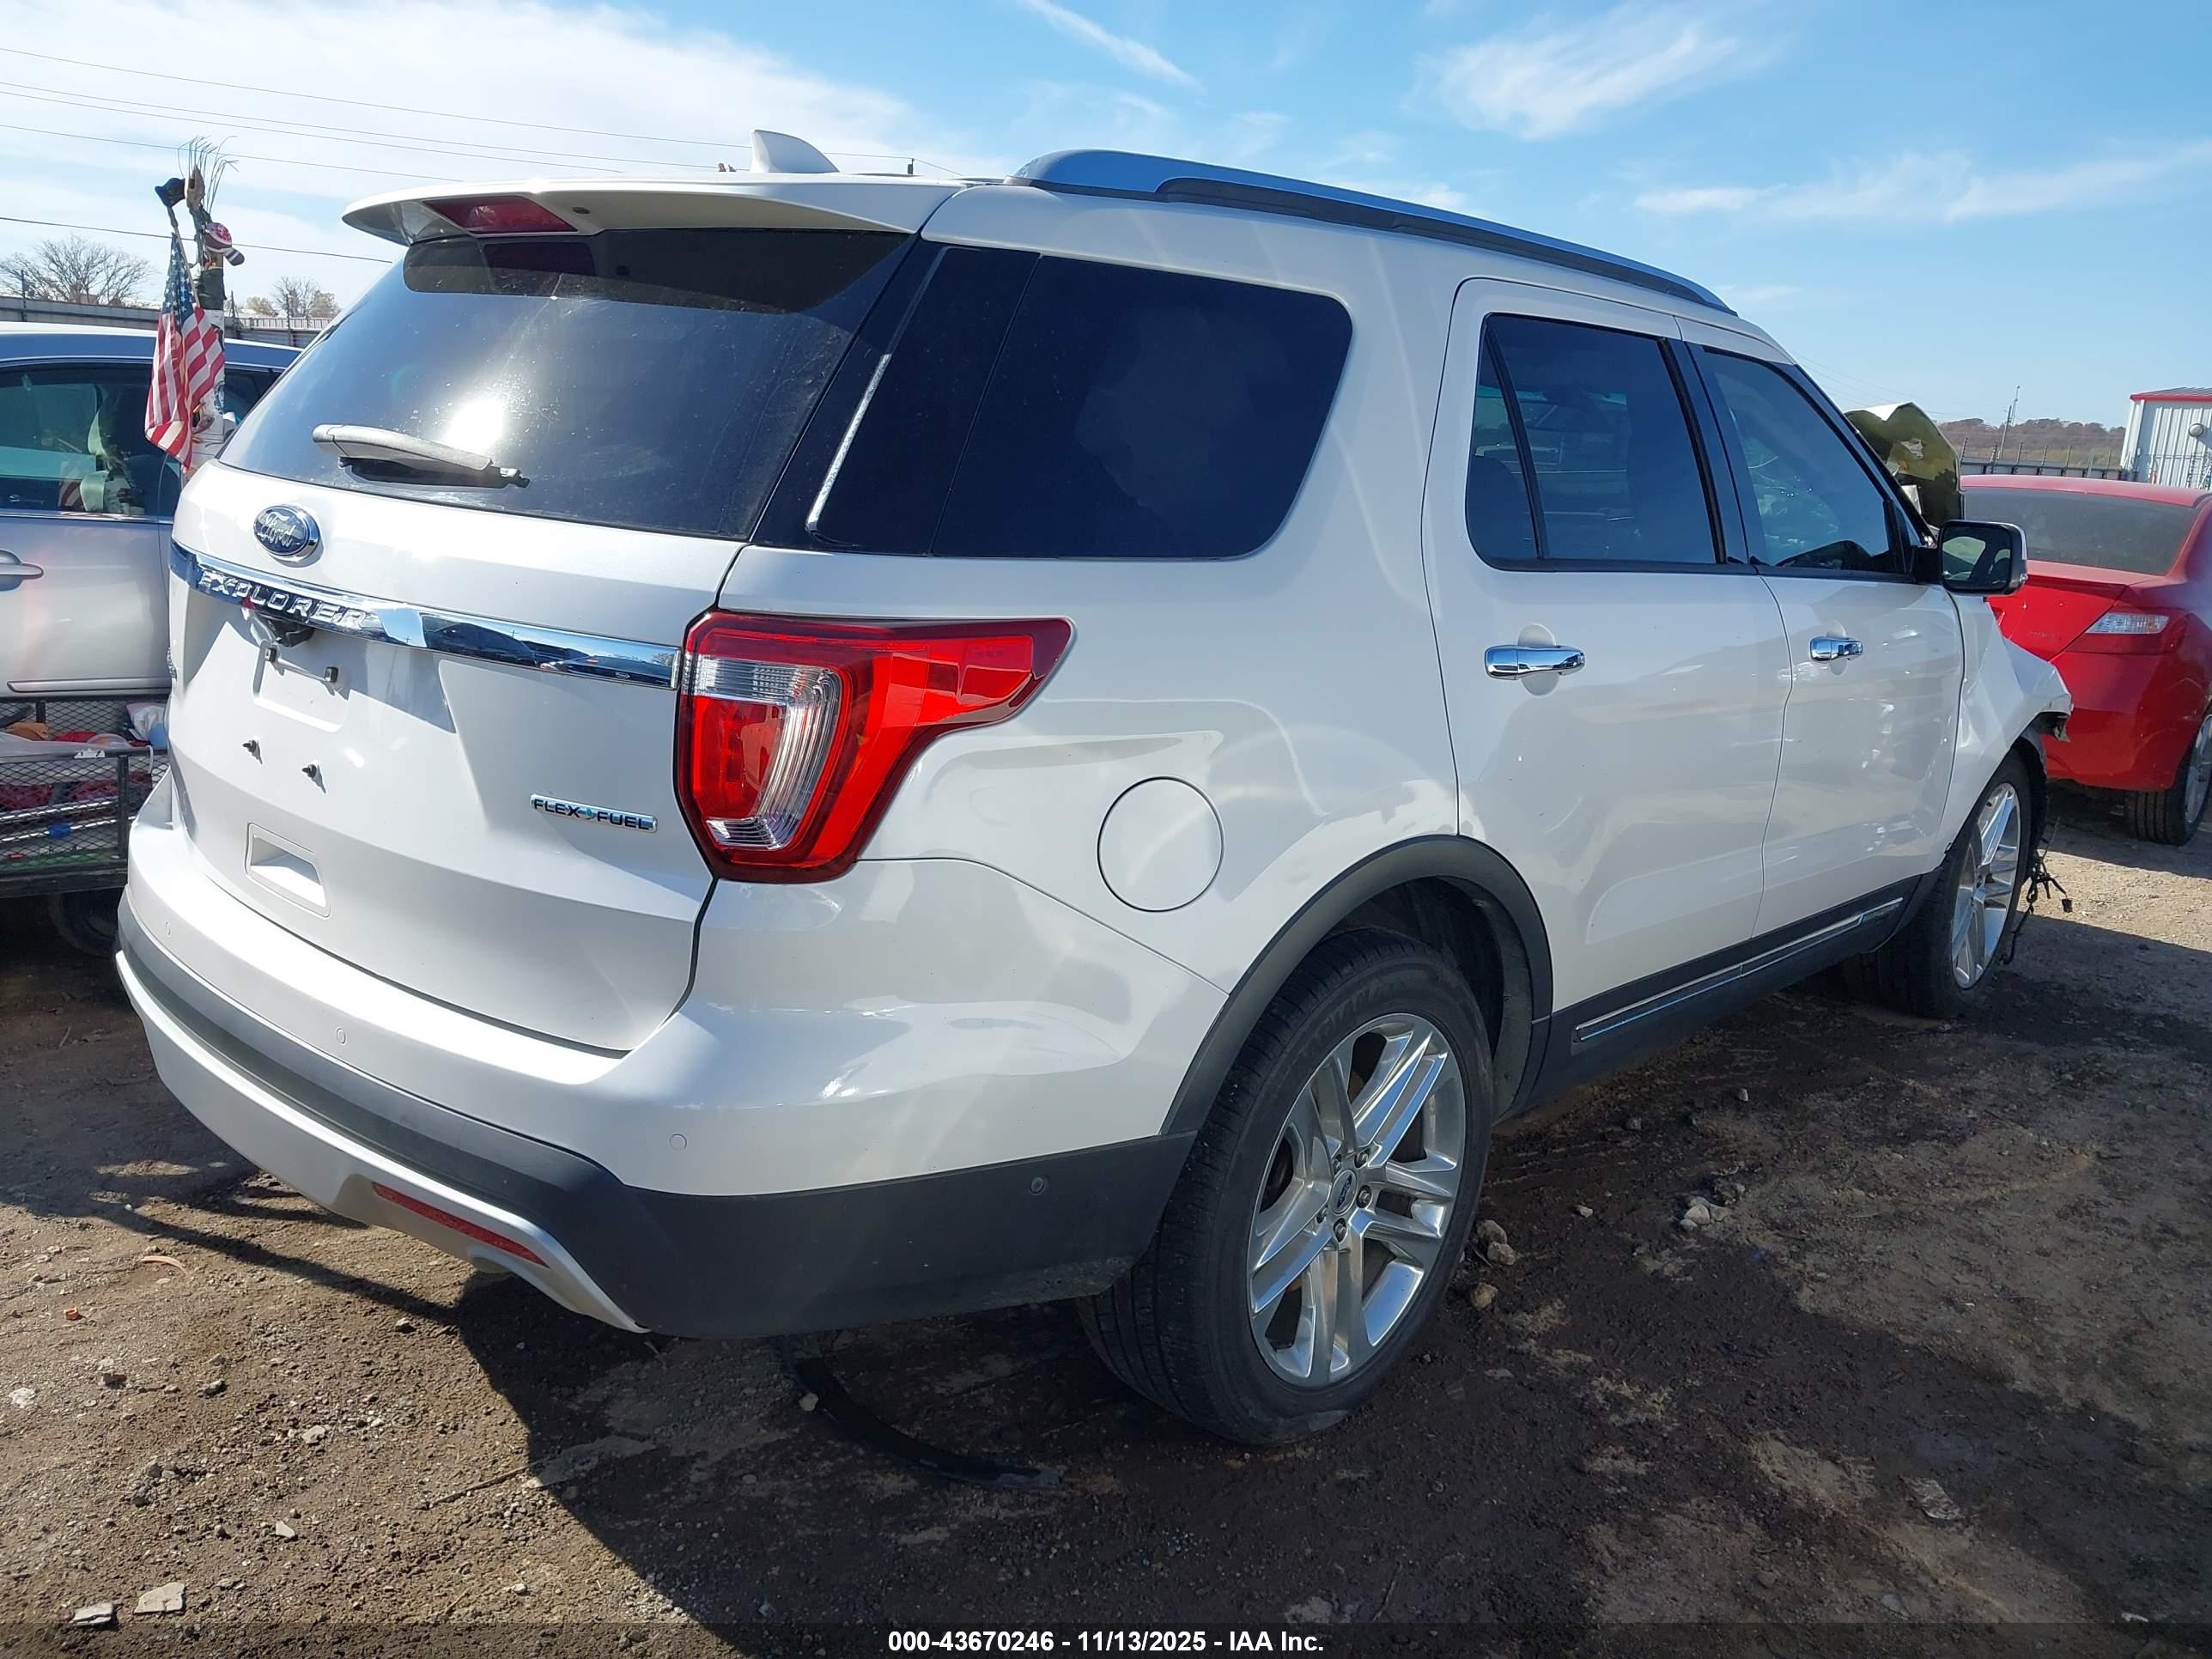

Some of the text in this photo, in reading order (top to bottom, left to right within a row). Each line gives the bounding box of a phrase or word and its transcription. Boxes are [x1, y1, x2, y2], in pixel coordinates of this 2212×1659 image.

[258, 512, 296, 547] Ford
[198, 570, 367, 629] EXPLORER
[534, 799, 649, 830] FLEX FUEL
